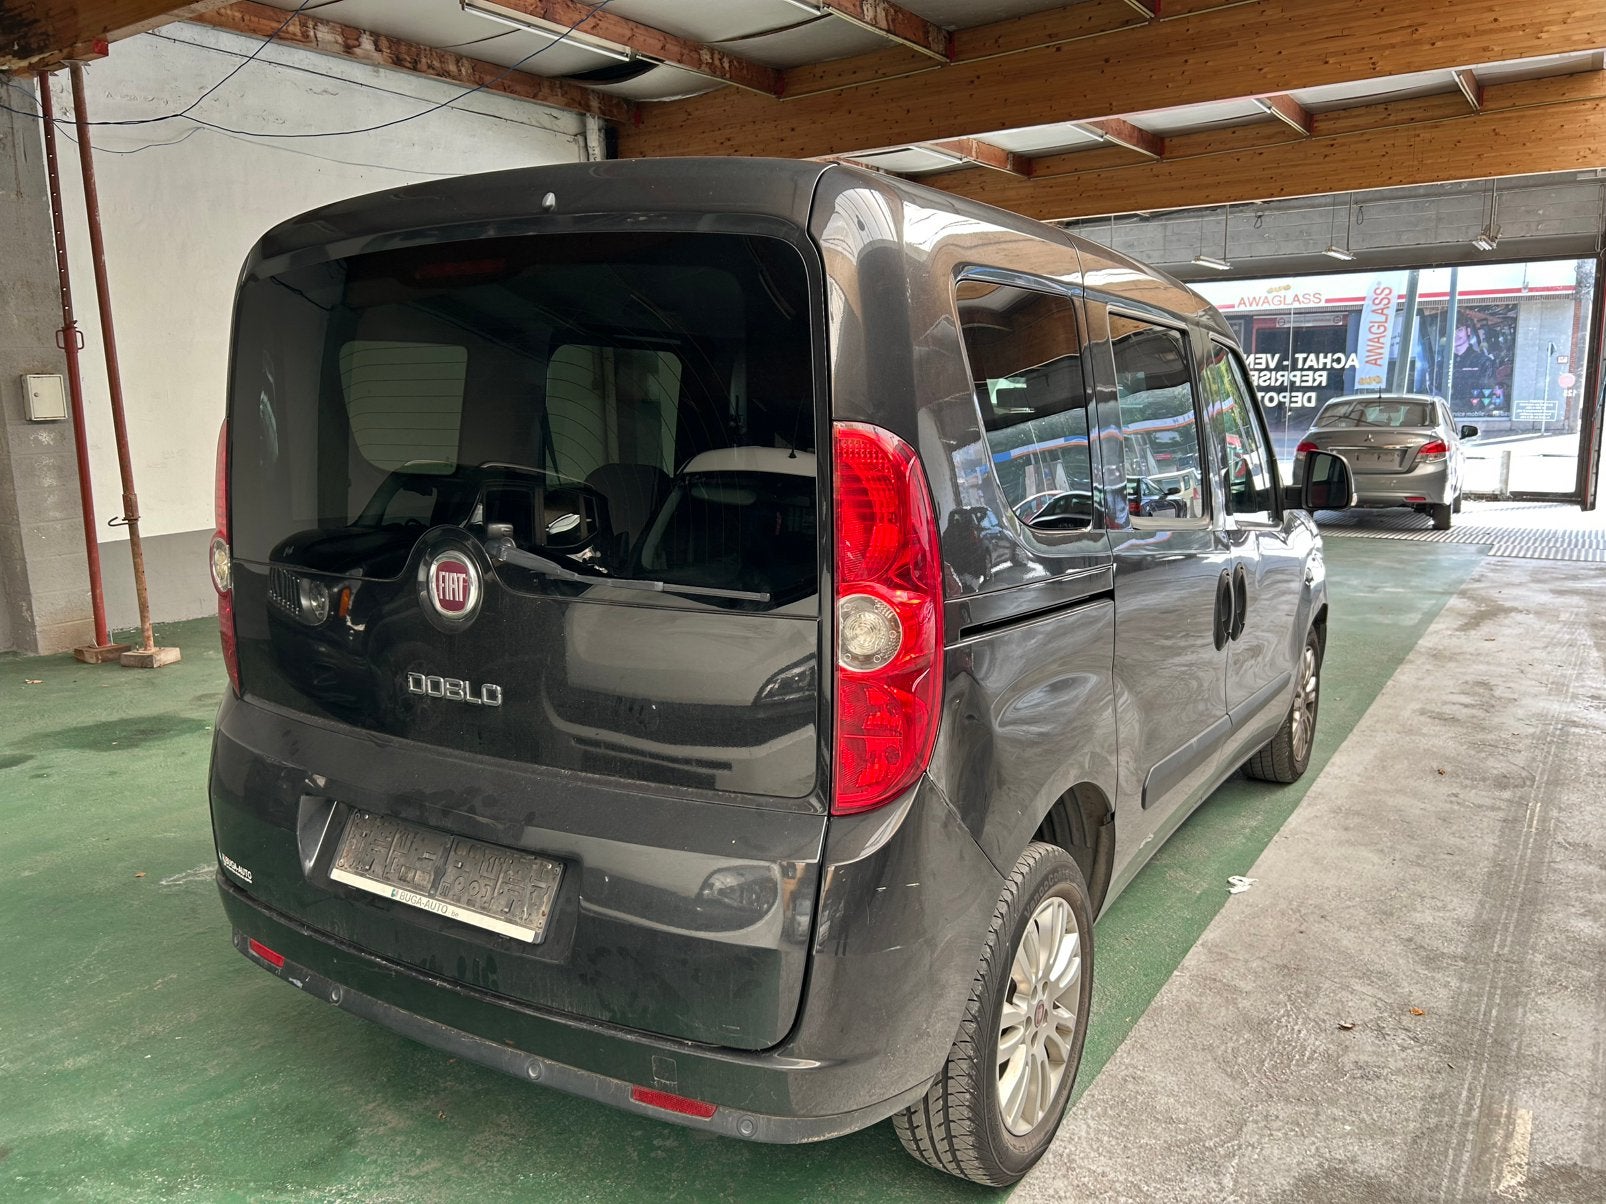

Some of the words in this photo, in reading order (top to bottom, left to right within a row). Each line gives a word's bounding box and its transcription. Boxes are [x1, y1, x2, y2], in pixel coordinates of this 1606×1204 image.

[1237, 292, 1323, 308] AWAGLASS
[1364, 286, 1393, 367] AWAGLASS
[438, 571, 467, 602] FIAT
[407, 671, 503, 707] DOBLO
[399, 891, 448, 914] BUGA-AUTO
